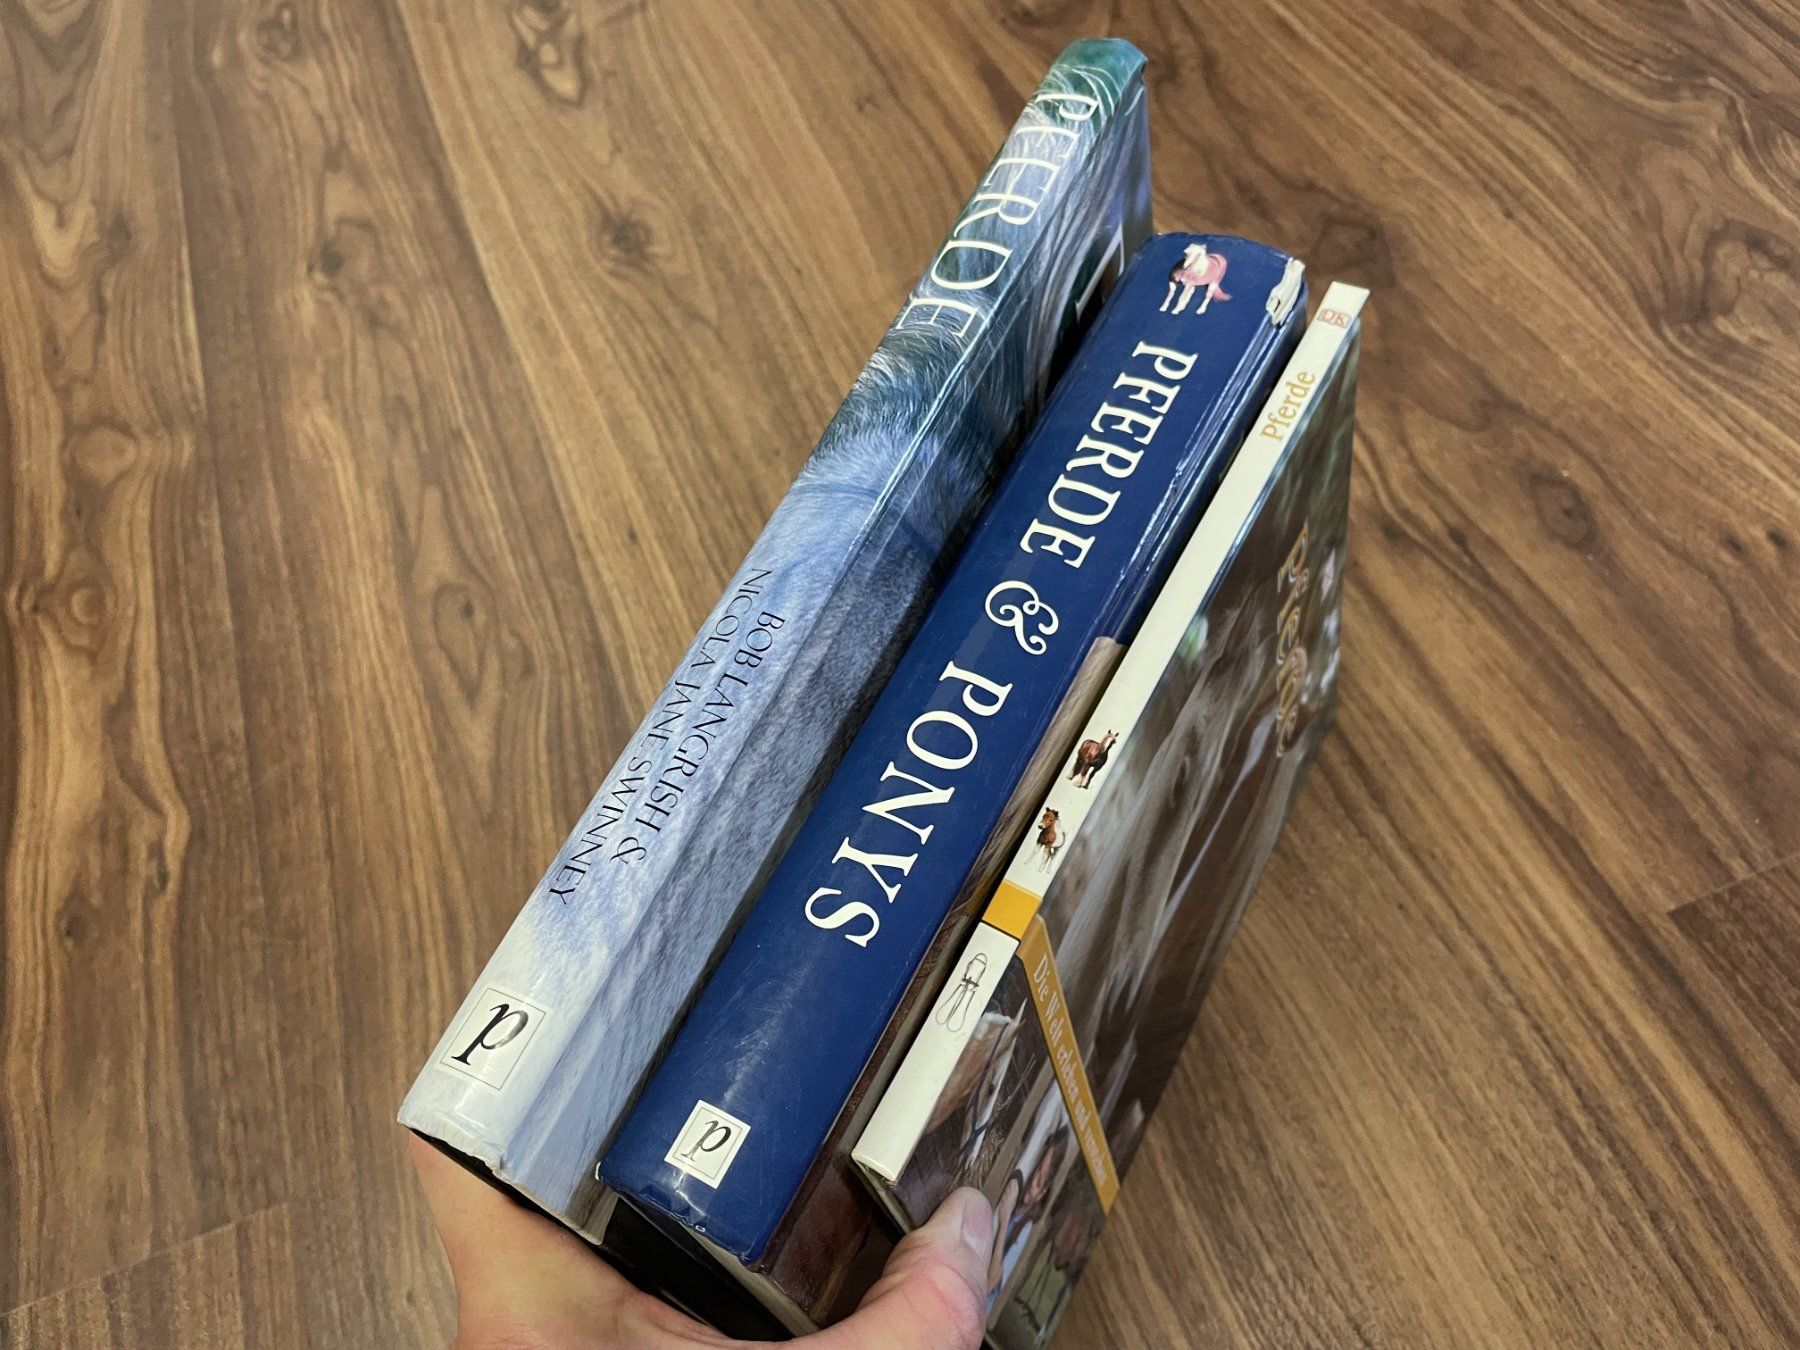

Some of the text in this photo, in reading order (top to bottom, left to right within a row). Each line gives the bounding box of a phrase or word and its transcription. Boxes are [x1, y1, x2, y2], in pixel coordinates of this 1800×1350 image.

[896, 93, 1100, 338] PFERDE
[1318, 309, 1349, 328] DK
[1260, 371, 1316, 442] Pferde
[548, 568, 773, 906] NICOLA JANE SWINNEY
[609, 611, 786, 865] BOB LANGRISH &
[804, 341, 1199, 948] PFERDE & PONYS
[1276, 516, 1309, 757] Pferde
[1033, 952, 1050, 1002] Die
[1045, 991, 1065, 1047] Welt
